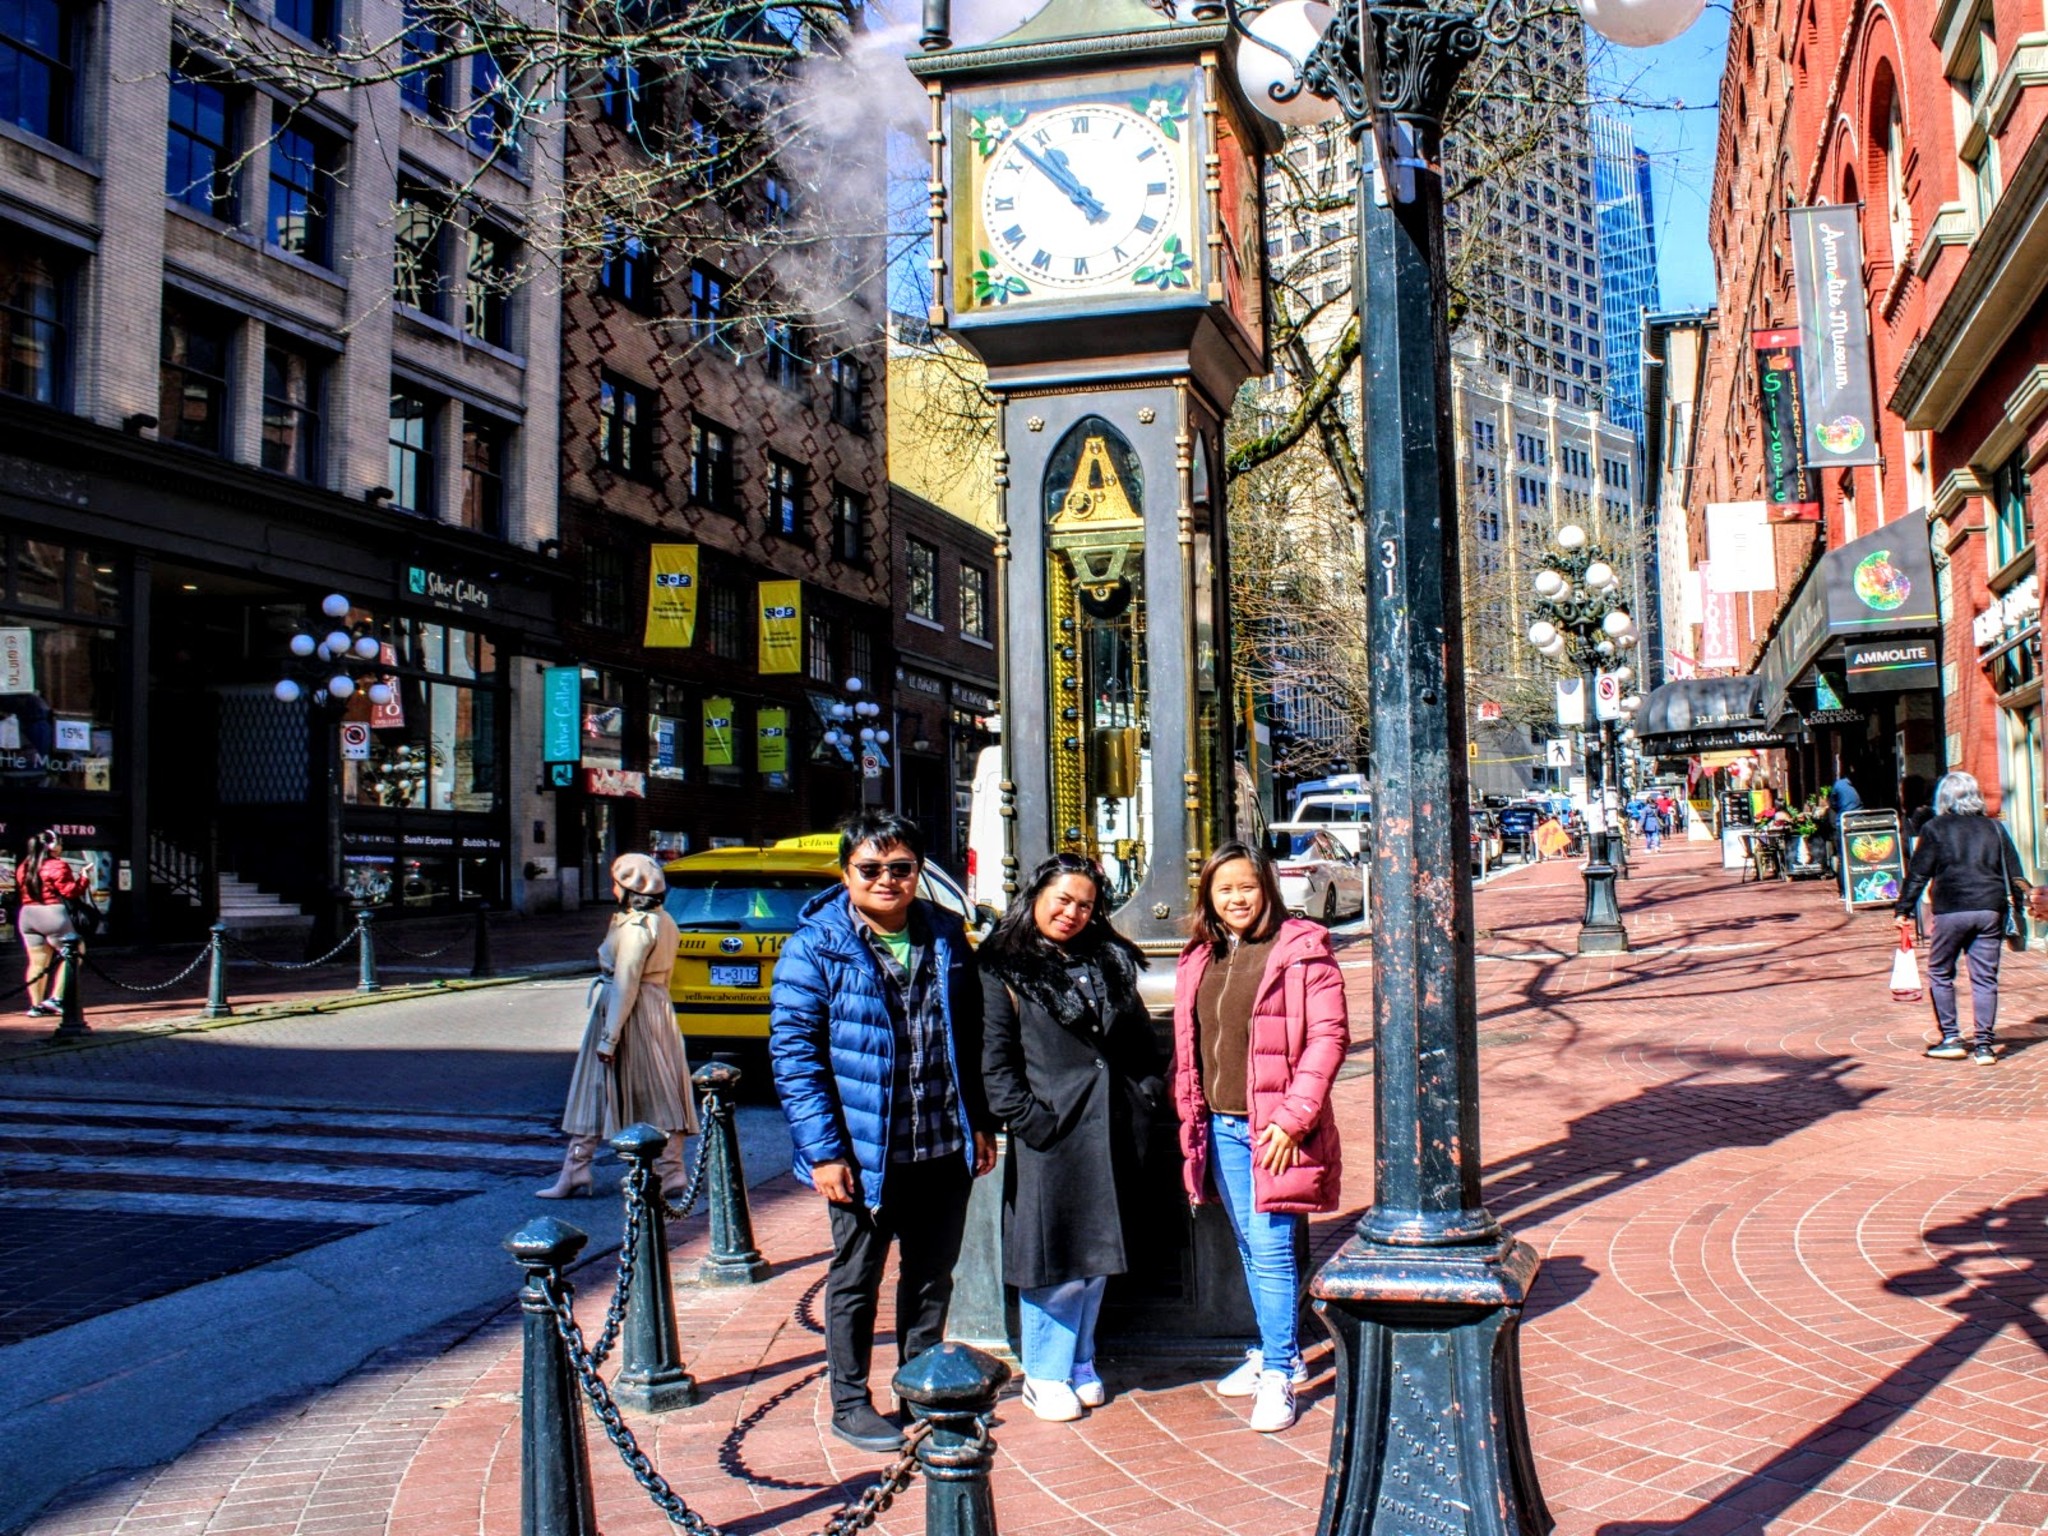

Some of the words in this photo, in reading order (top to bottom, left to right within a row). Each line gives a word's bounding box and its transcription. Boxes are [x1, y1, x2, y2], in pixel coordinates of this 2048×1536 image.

[1071, 116, 1090, 134] XII
[1829, 310, 1849, 390] Museum
[1763, 373, 1787, 502] Silvestre
[1381, 540, 1397, 599] 31
[427, 571, 454, 597] Silver
[455, 578, 489, 609] Gallery
[1853, 646, 1928, 665] AMMOLITE
[553, 672, 574, 717] Gallery
[1695, 715, 1713, 726] 321
[1810, 708, 1857, 719] CANADIAN
[1836, 714, 1865, 723] ROCKS
[61, 728, 84, 740] 15%
[553, 721, 572, 757] Silver
[54, 824, 96, 835] RETRO
[404, 835, 424, 845] Sushi
[425, 835, 453, 846] Express
[463, 838, 487, 848] Bubble
[797, 838, 834, 848] Yellow
